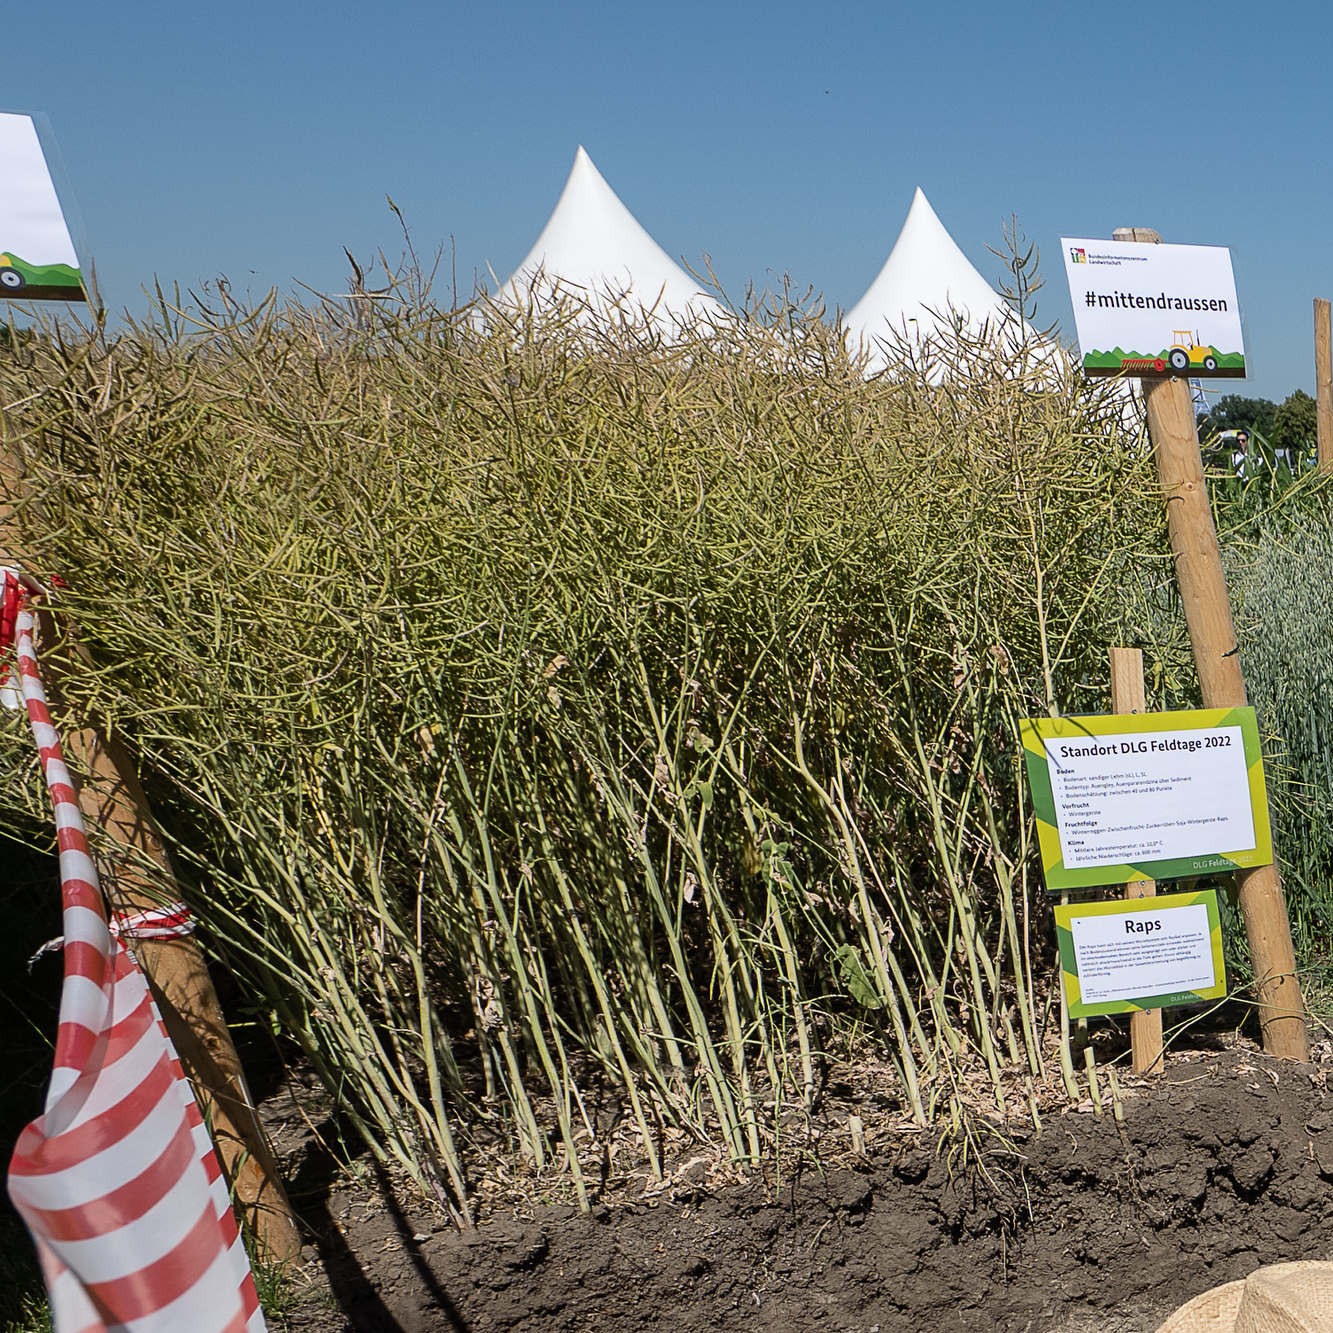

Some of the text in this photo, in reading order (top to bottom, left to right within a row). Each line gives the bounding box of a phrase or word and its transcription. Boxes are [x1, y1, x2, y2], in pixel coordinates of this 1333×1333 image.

[1085, 290, 1228, 312] #mittendraussen
[1060, 736, 1231, 758] Standort DLG Feldtage 2022
[1065, 820, 1098, 828] Fruchtfolge
[1193, 861, 1207, 869] DLG
[1125, 920, 1161, 935] Raps
